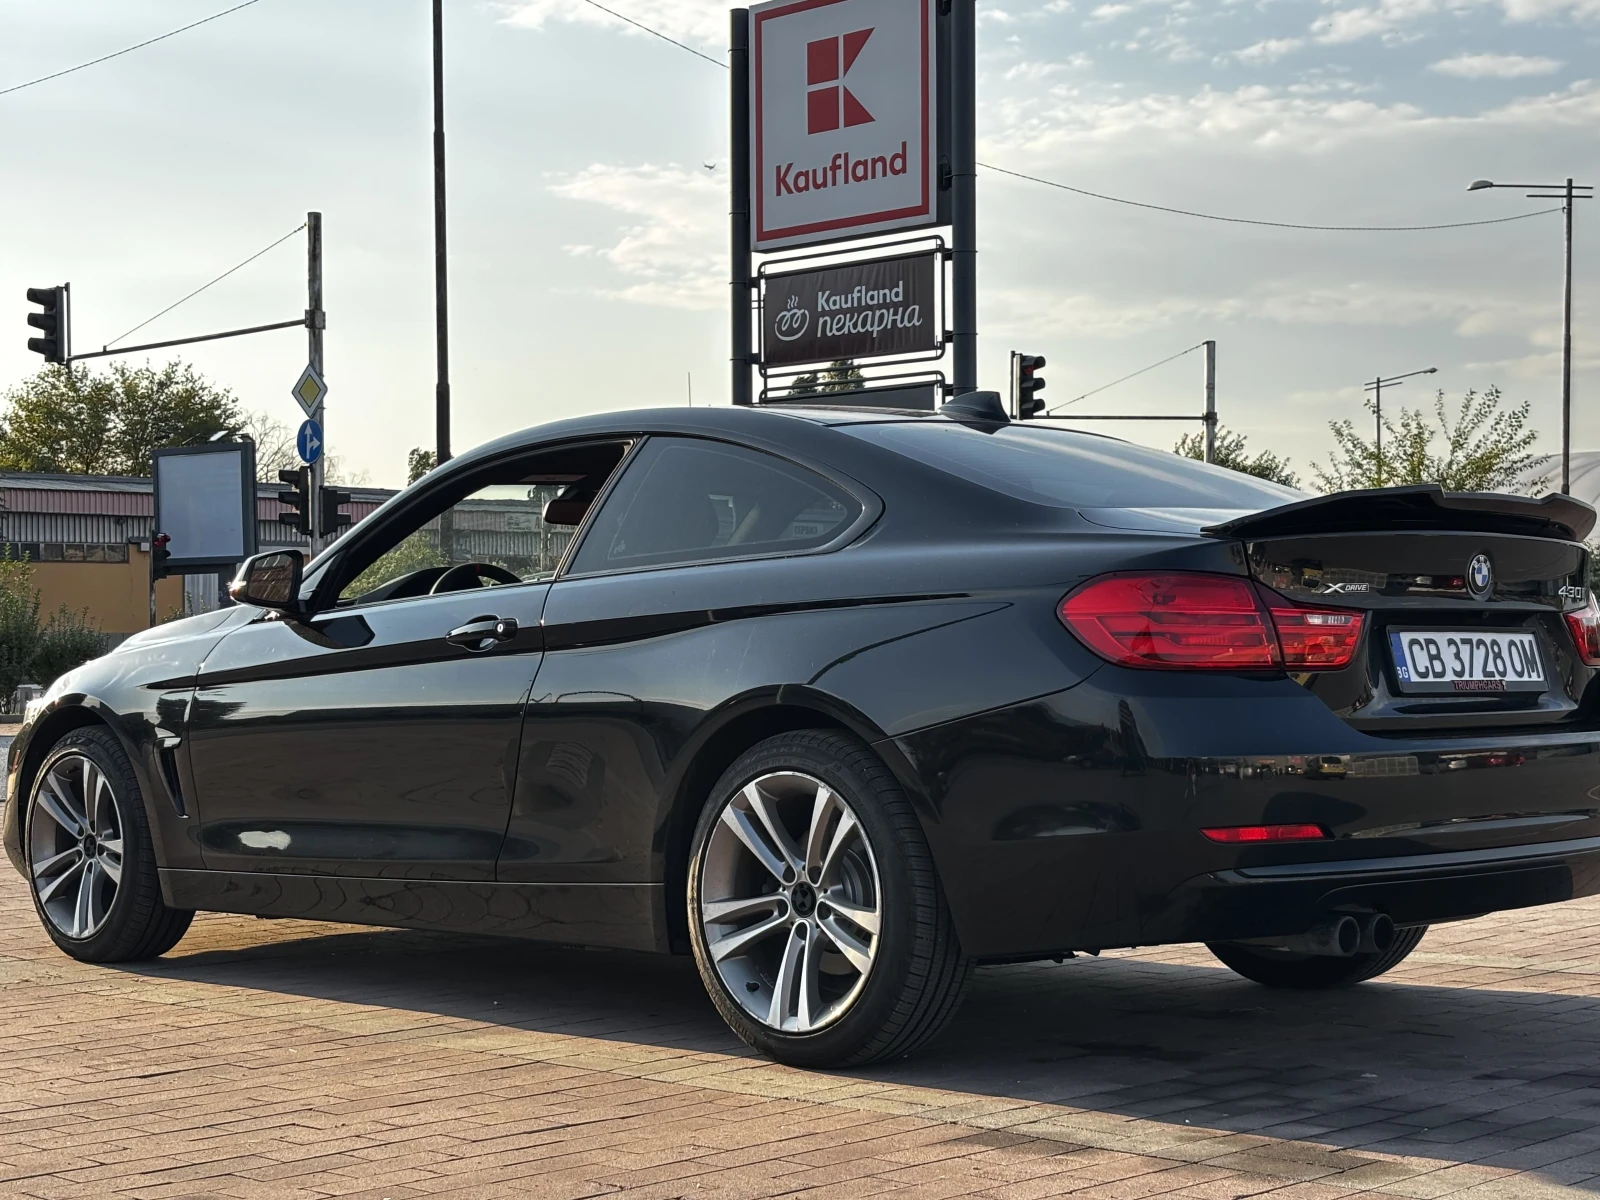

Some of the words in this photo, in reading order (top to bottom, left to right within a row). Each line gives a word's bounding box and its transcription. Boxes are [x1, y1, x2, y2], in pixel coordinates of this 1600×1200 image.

[775, 141, 907, 197] Kaufland
[817, 280, 903, 312] Kaufland
[817, 304, 922, 338] пекарна
[1408, 638, 1446, 679] CB
[1447, 638, 1507, 679] 3728
[1507, 639, 1541, 679] OM
